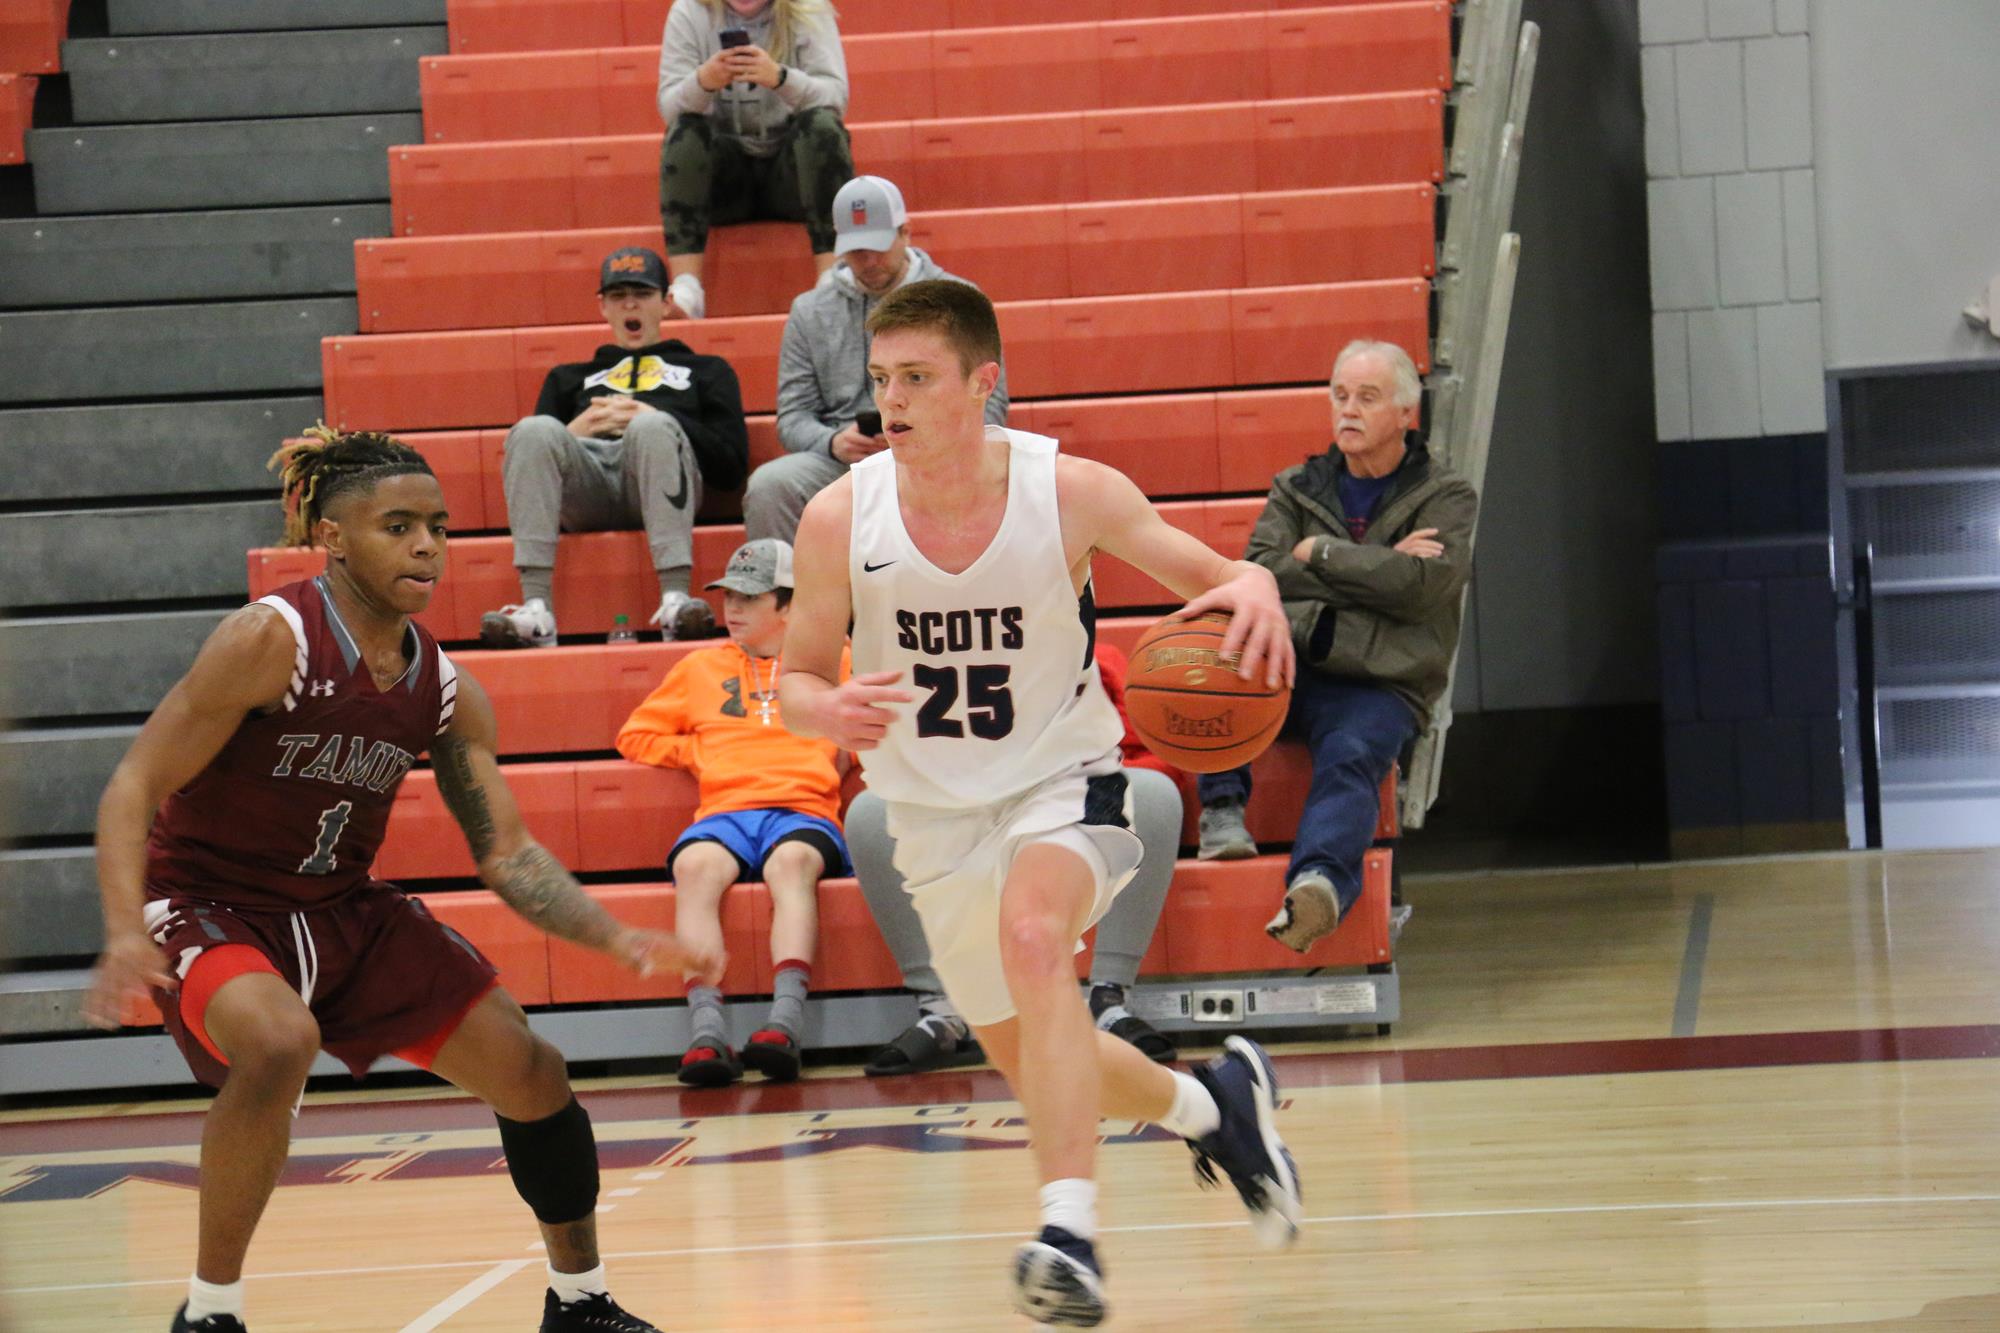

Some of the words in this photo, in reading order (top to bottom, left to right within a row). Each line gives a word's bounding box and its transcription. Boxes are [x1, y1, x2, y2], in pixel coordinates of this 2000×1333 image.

[896, 606, 1024, 655] SCOTS
[913, 663, 1015, 741] 25
[298, 800, 352, 874] 1
